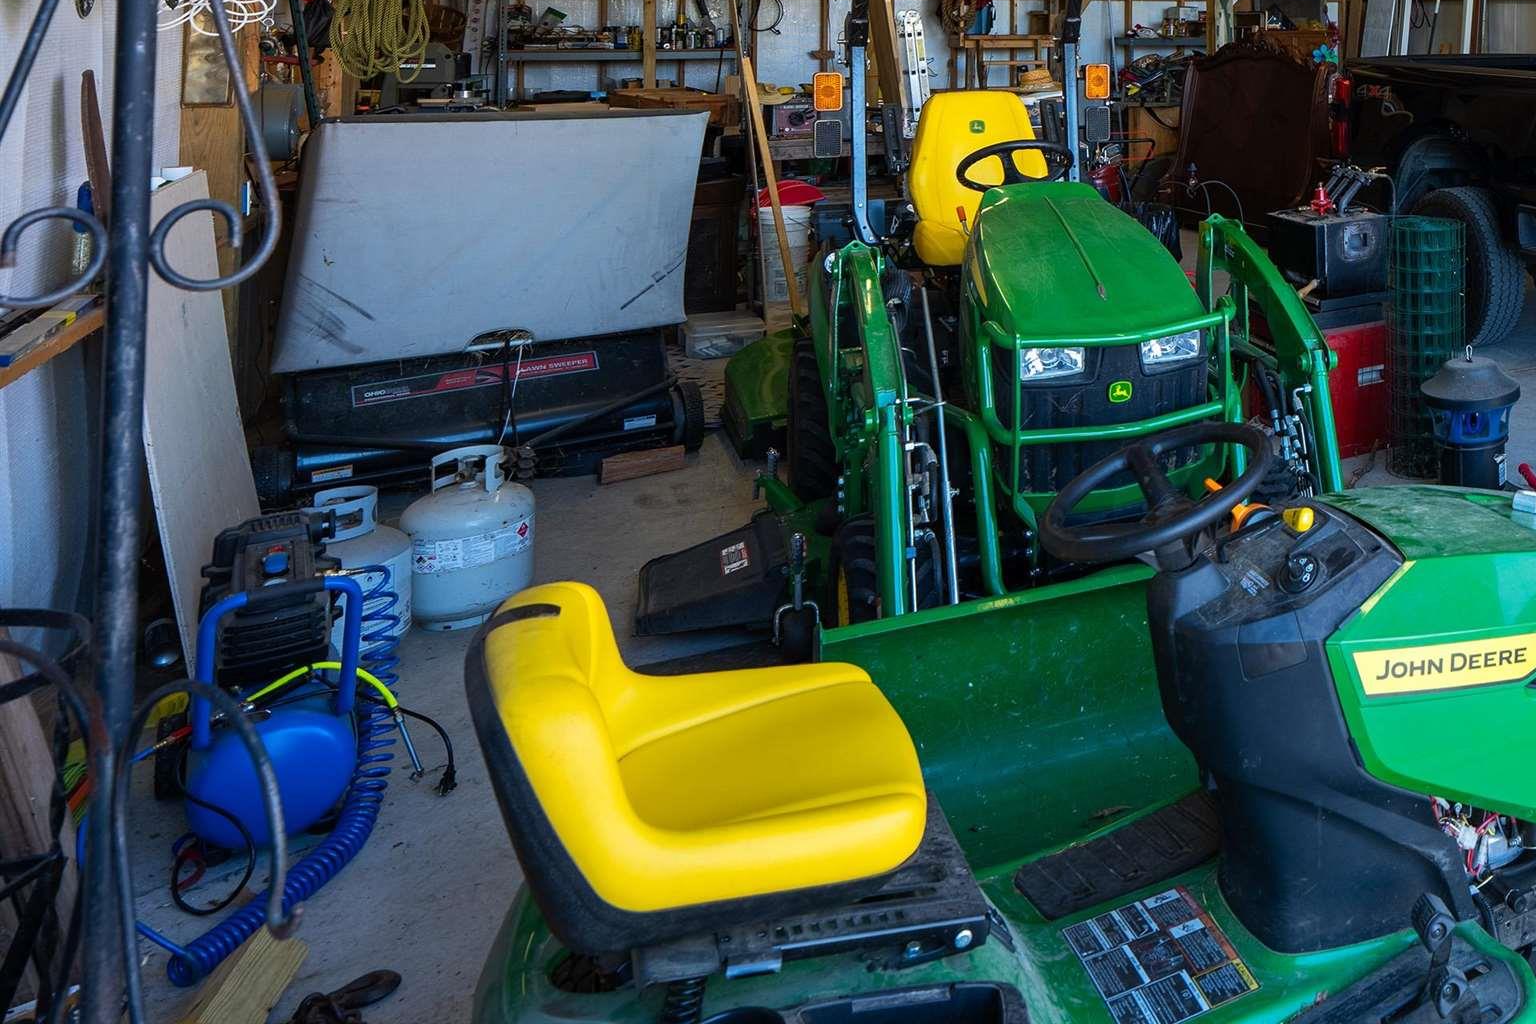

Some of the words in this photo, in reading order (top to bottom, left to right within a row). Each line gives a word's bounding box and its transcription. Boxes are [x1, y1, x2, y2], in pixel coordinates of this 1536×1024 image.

[548, 357, 588, 368] SWEEPER
[1376, 659, 1444, 681] JOHN
[1449, 647, 1528, 673] DEERE
